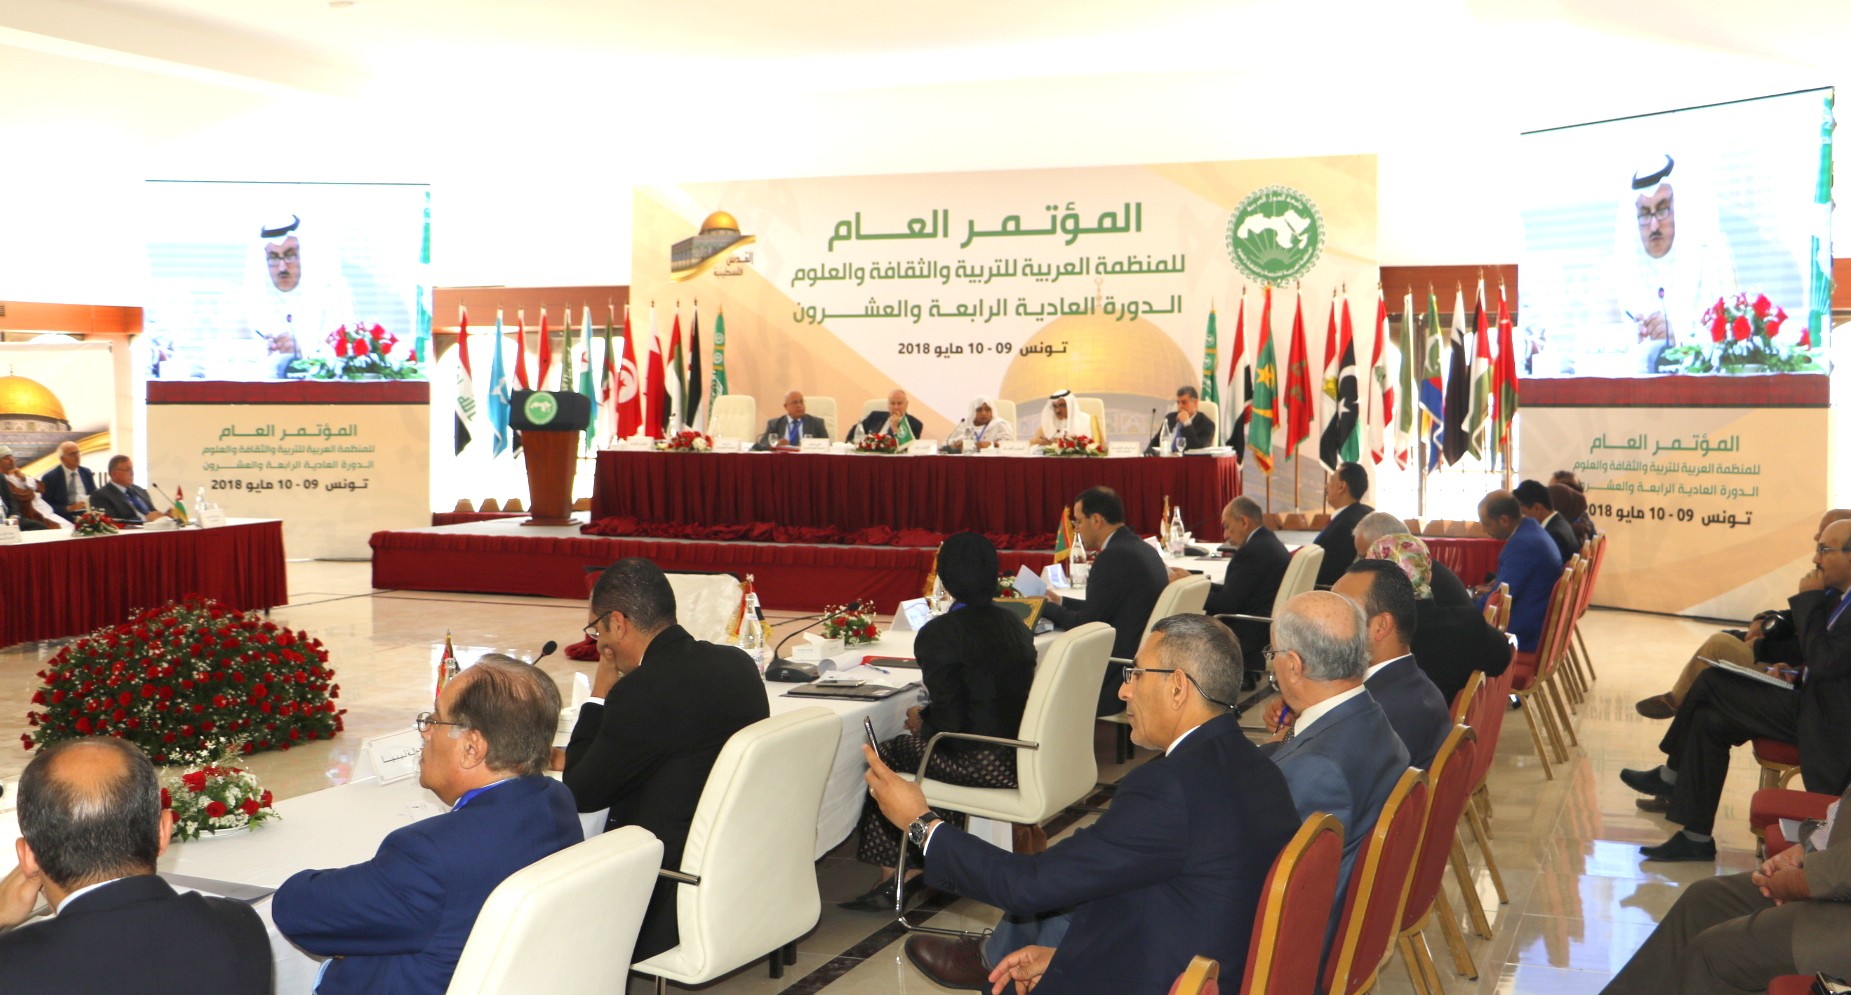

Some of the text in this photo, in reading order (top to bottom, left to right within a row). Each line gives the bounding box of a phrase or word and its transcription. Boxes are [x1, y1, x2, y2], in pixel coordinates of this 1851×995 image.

[828, 201, 1142, 252] المؤتمر العام
[791, 254, 1186, 288] للمنظمة العربية للتربية والثقافة والعلوم
[793, 294, 1182, 325] الدورة العادية الرابعة والعشرون
[898, 342, 930, 355] 2018
[934, 342, 964, 359] مايو
[968, 342, 984, 355] 10
[995, 342, 1013, 354] 09
[1019, 341, 1069, 357] تونس
[218, 423, 358, 441] المؤتمر العام
[1589, 433, 1740, 457] المؤتمر العام
[1572, 459, 1761, 477] للمنظمة العربية للتربية والثقافة والعلوم
[211, 479, 242, 490] 2018
[246, 479, 274, 494] مايو
[278, 479, 293, 490] 10
[303, 479, 319, 490] 09
[325, 478, 370, 492] تونس
[1637, 481, 1675, 497] الرابعة
[1677, 482, 1717, 497] العادية
[1719, 484, 1759, 500] الدورة
[1588, 502, 1613, 518] 018
[1616, 505, 1645, 524] مايو
[1649, 506, 1666, 521] 10
[1676, 507, 1694, 522] 09
[1701, 509, 1753, 529] تونس
